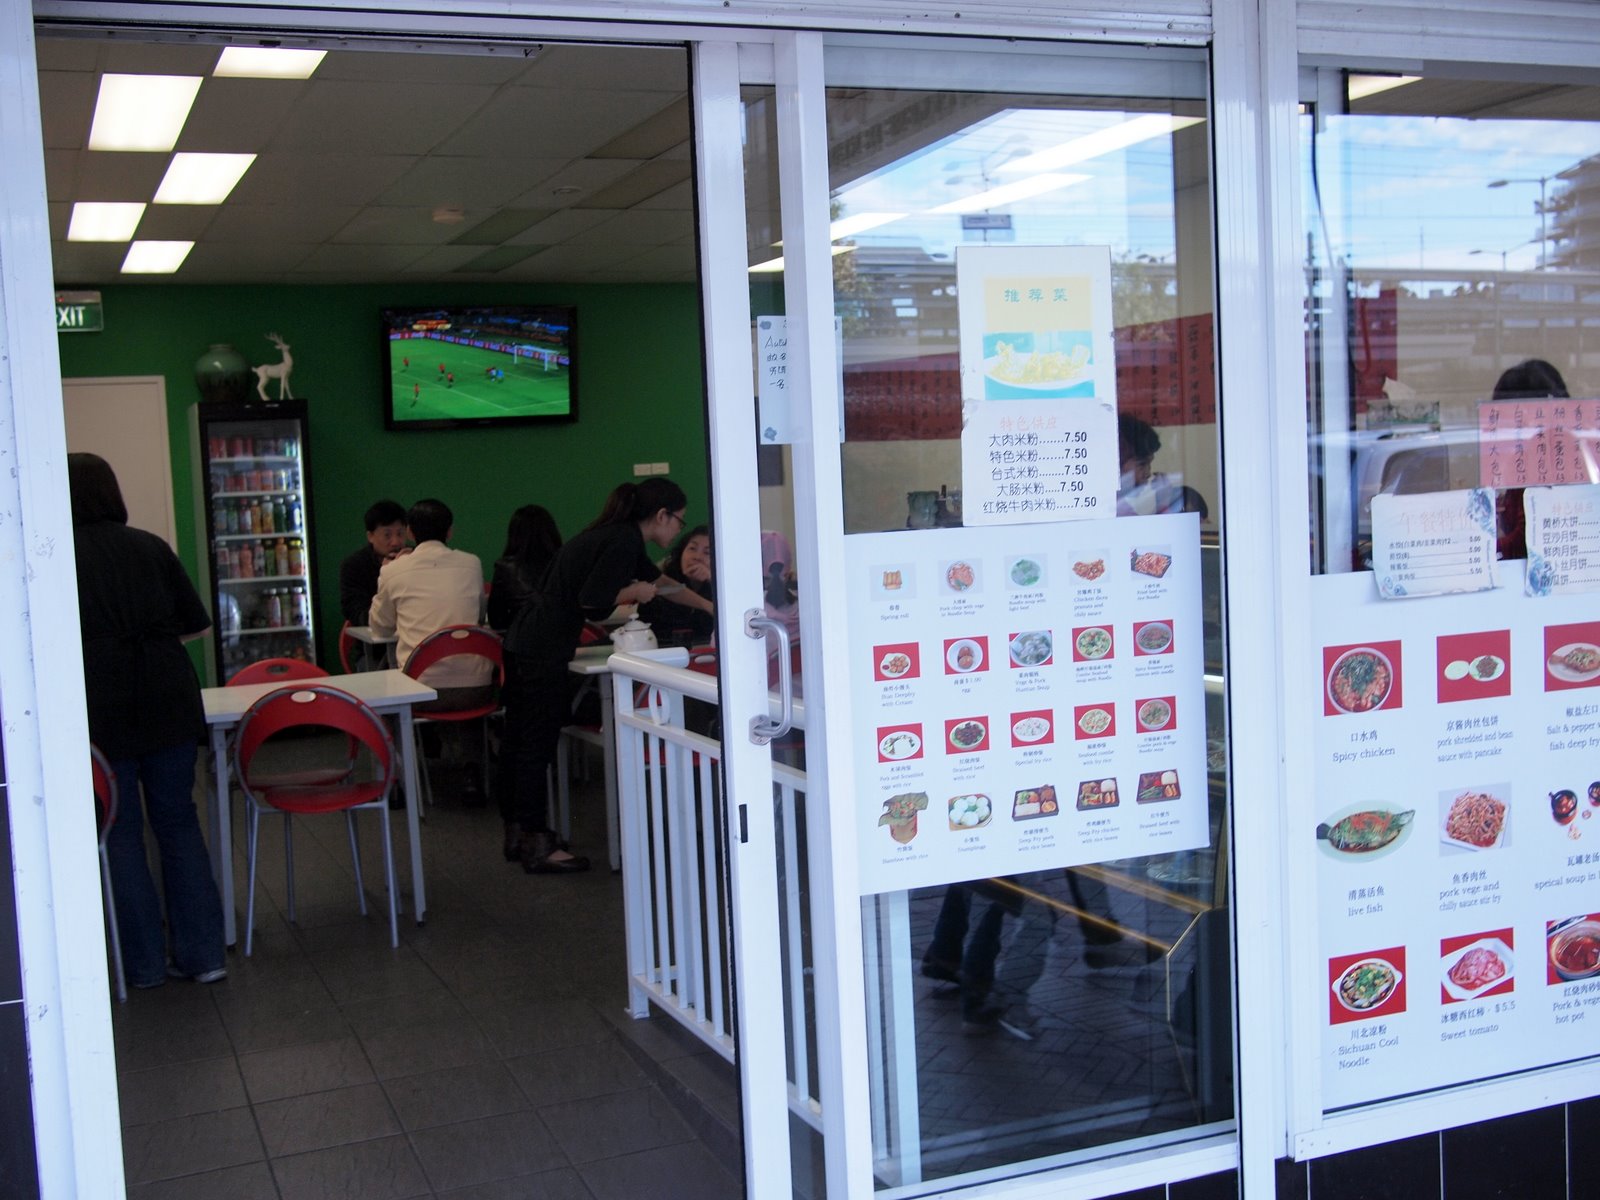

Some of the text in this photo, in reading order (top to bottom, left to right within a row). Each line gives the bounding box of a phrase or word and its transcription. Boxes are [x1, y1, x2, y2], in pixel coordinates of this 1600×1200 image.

[1004, 288, 1068, 303] 推荐菜
[56, 305, 86, 326] XIT
[990, 432, 1088, 447] 大肉米粉 7.50
[990, 448, 1088, 464] 特色米粉 7.50
[992, 464, 1088, 481] 台式米粉 7.50
[997, 481, 1084, 497] 大肠米粉 7.50
[983, 497, 1097, 514] 红烧牛肉米粉 7.50
[1542, 530, 1579, 544] 豆沙月饼
[1543, 545, 1579, 558] 鲜肉月饼
[1563, 723, 1569, 733] &
[1351, 730, 1378, 742] 口水鸡
[1549, 740, 1566, 751] fish
[1567, 738, 1587, 750] deep
[1331, 747, 1396, 763] Spicy chicken
[1458, 749, 1473, 760] with
[1453, 869, 1488, 885] 鱼香肉丝
[1565, 874, 1586, 884] soup
[1439, 887, 1460, 900] pork
[1483, 880, 1500, 891] and
[1348, 902, 1384, 917] live fish
[1555, 1011, 1585, 1024] hot pot
[1440, 1022, 1500, 1043] Sweet tomato
[1338, 1036, 1399, 1058] Sichuan Cool
[1338, 1056, 1371, 1071] Noodle
